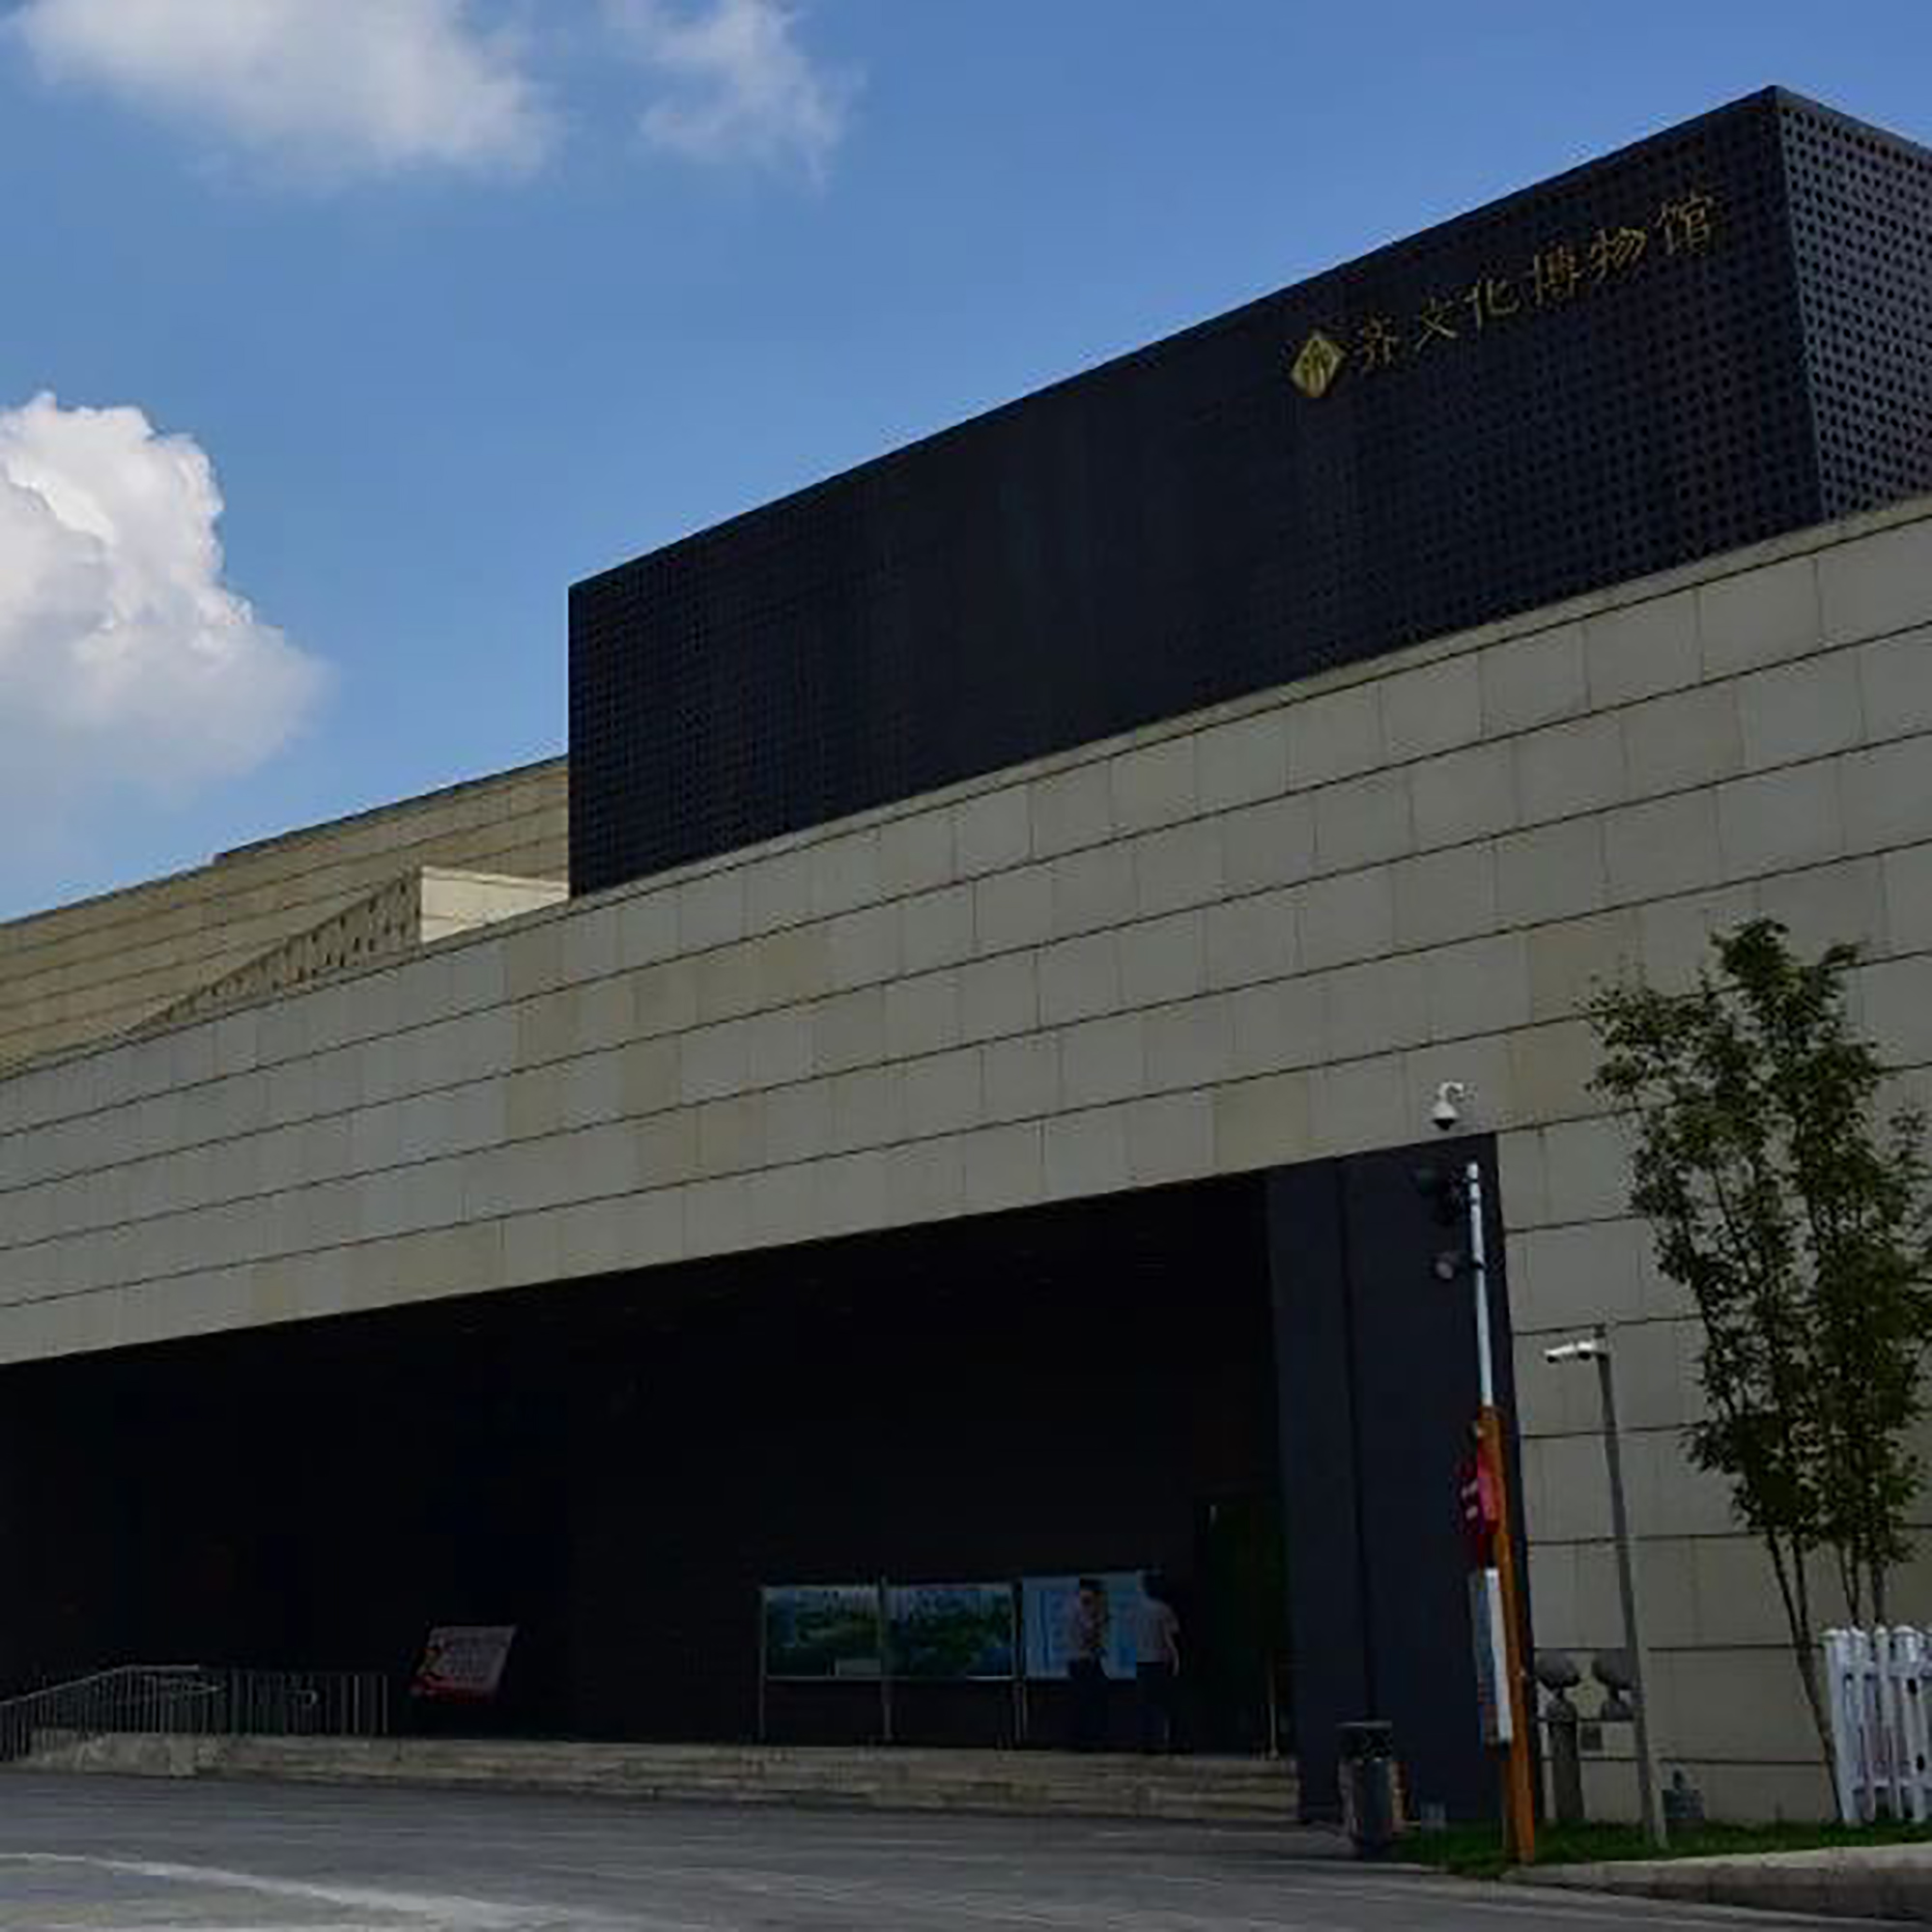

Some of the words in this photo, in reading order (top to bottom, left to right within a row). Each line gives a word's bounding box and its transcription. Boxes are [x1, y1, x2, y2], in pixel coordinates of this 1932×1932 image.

[1356, 191, 1715, 373] 齐文化博物馆
